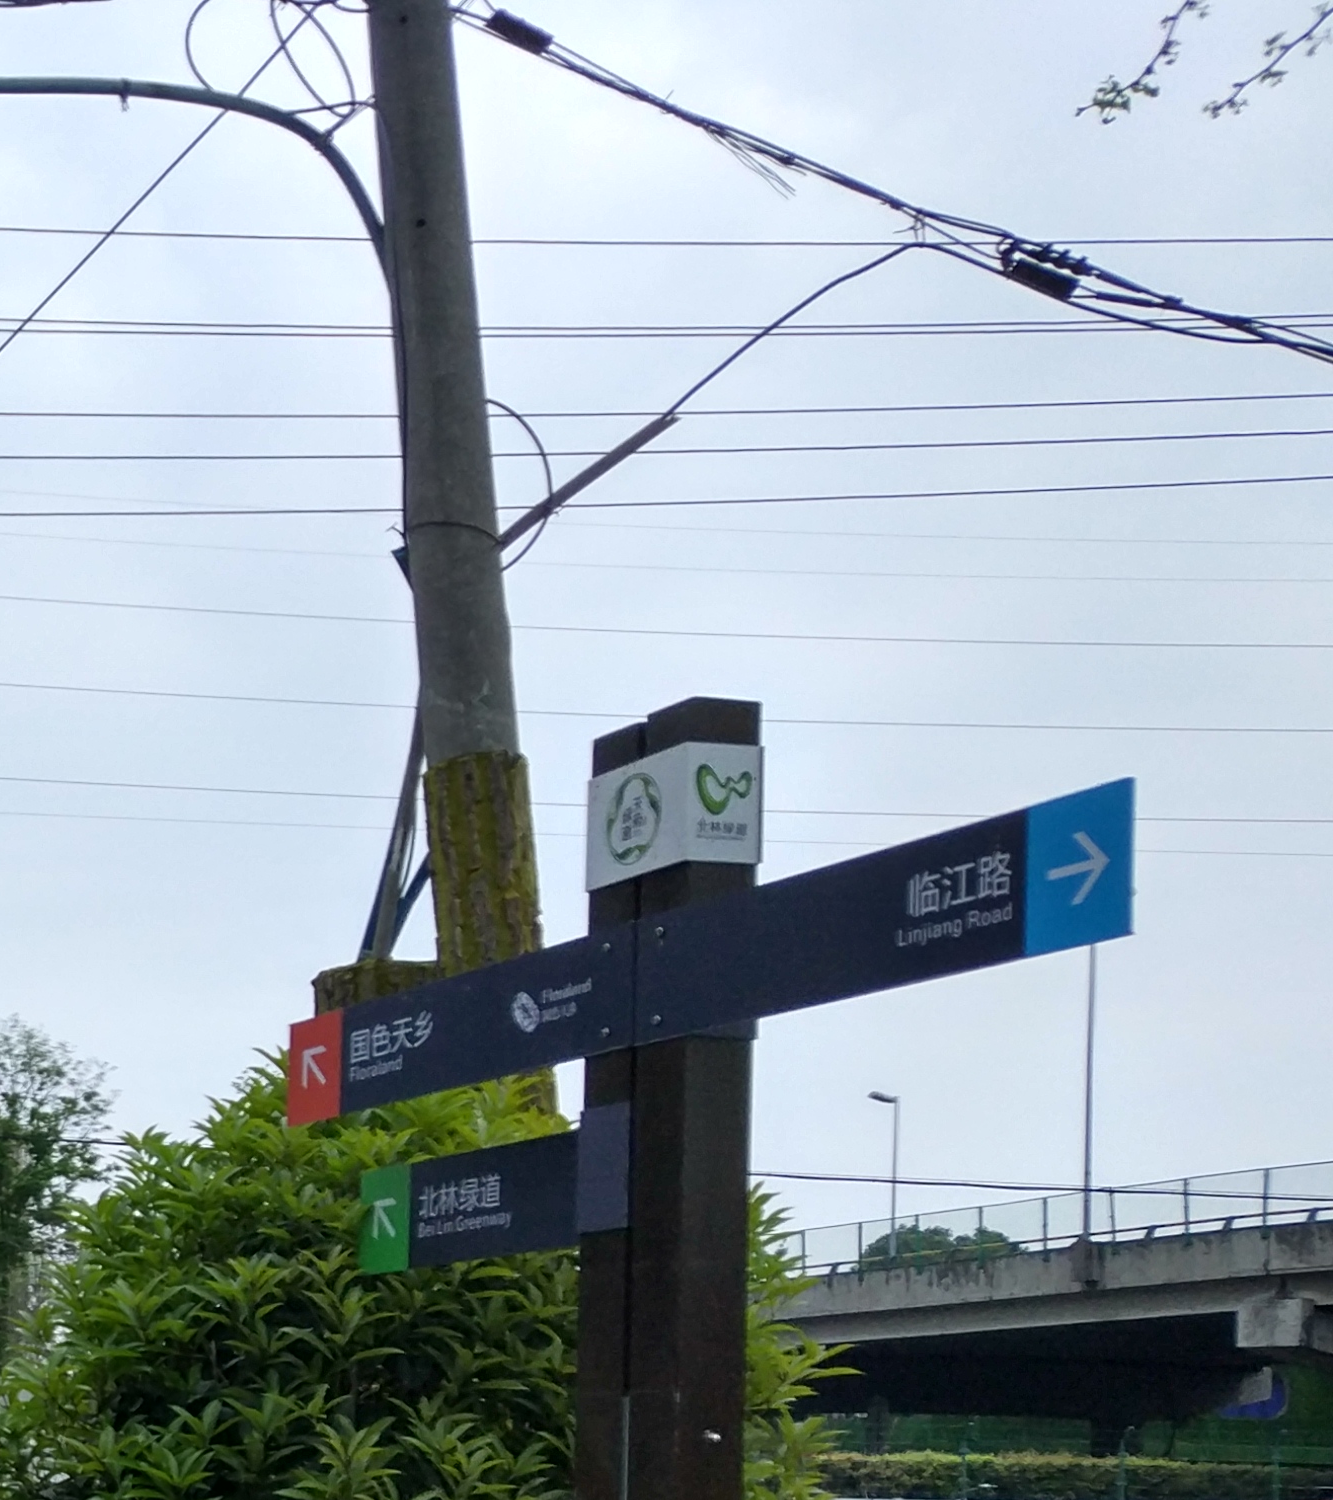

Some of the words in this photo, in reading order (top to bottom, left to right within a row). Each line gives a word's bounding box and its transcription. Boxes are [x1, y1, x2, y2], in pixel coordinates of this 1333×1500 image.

[907, 850, 1012, 917] 临江路
[896, 918, 962, 947] Linjiang
[967, 901, 1013, 928] Road
[349, 1010, 434, 1064] 国色天乡
[349, 1055, 403, 1082] Floraland
[418, 1172, 501, 1219] 北林绿道
[455, 1212, 512, 1232] Greenway
